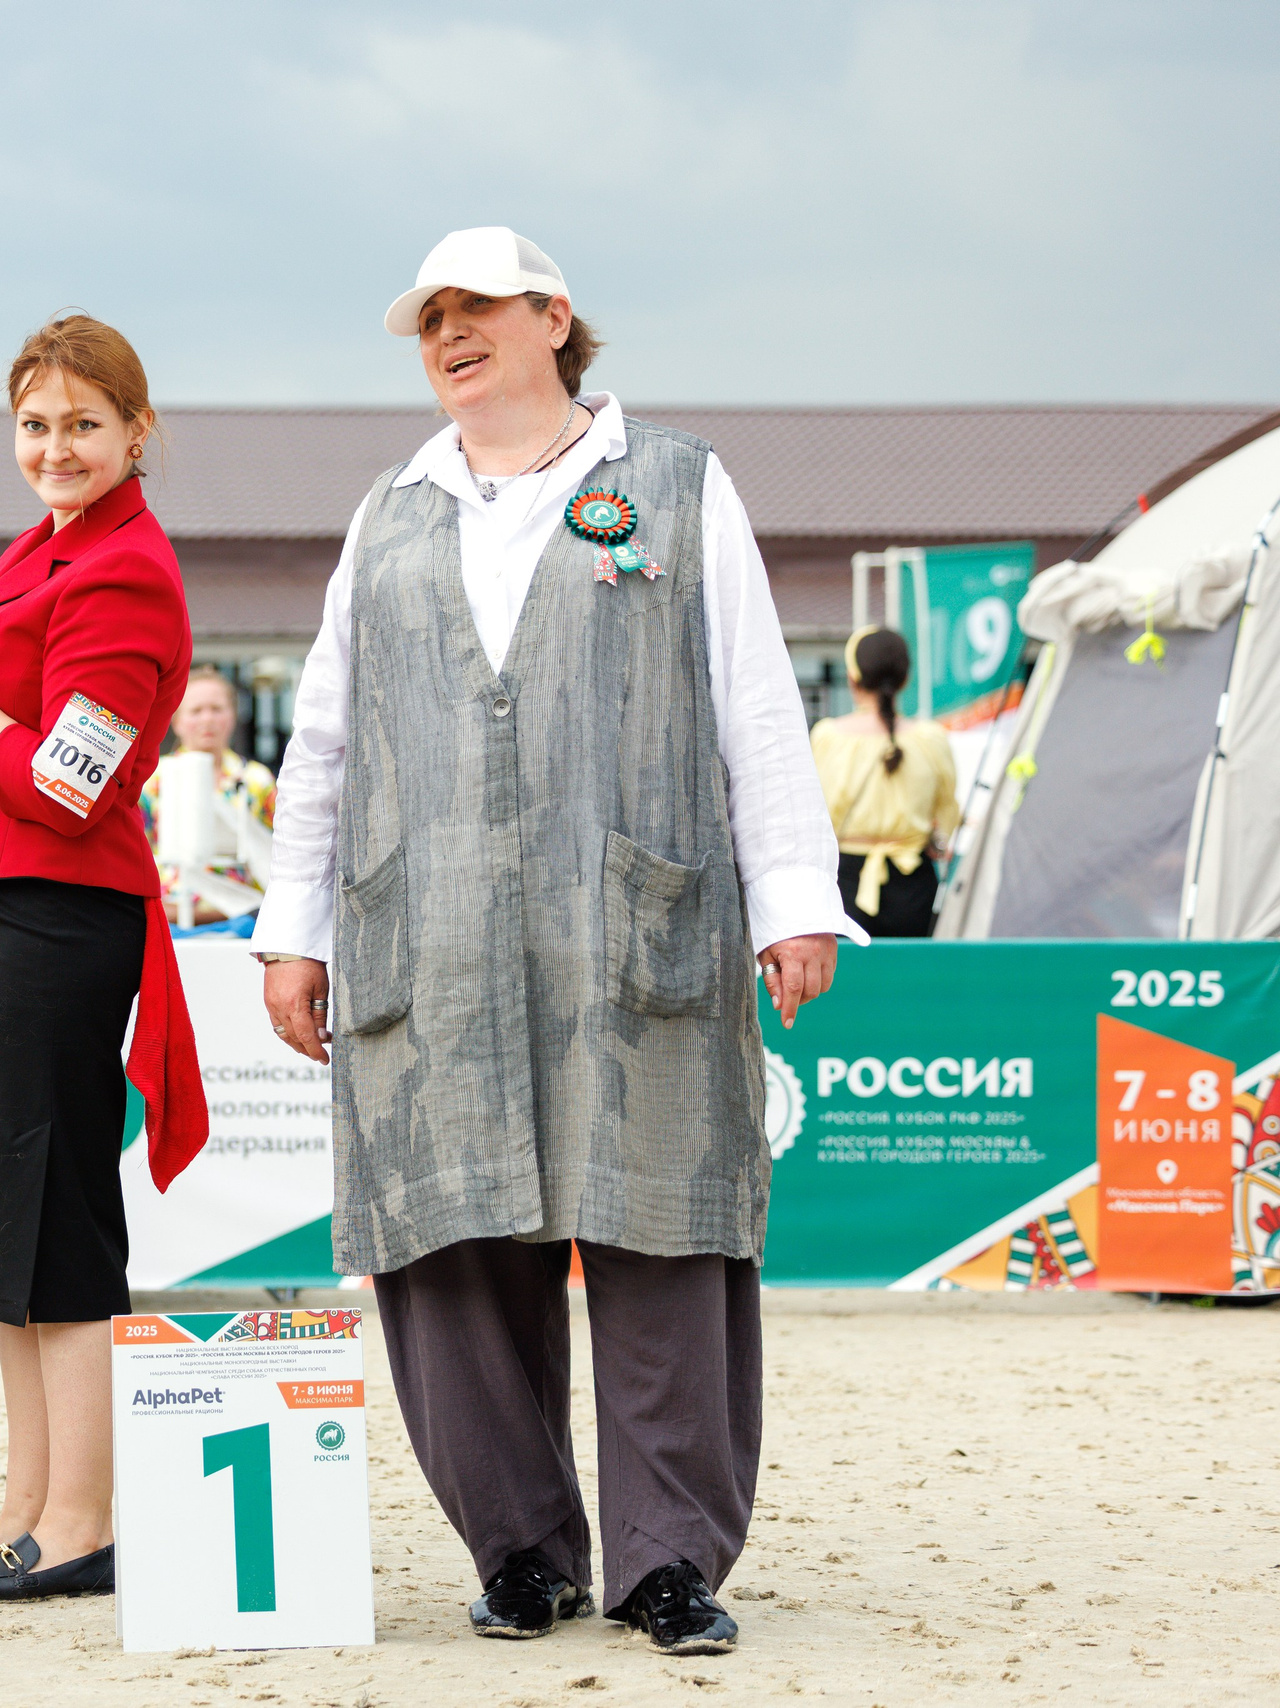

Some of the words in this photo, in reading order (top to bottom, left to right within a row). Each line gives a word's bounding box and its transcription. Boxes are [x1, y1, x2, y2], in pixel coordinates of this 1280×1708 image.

[966, 596, 1012, 682] 9
[89, 722, 116, 742] РОССИЯ
[49, 737, 106, 784] 1016
[55, 783, 89, 808] 8.06.2025
[1110, 969, 1225, 1008] 2025
[817, 1056, 1034, 1098] РОССИЯ
[1114, 1070, 1147, 1112] 7
[1186, 1070, 1221, 1112] 8
[895, 1110, 947, 1126] КУБОК
[1114, 1118, 1221, 1143] ИЮНЯ
[895, 1134, 947, 1149] КУБОК
[949, 1134, 1017, 1149] МОСКВЫ
[125, 1325, 158, 1337] 2025
[132, 1387, 223, 1409] AlphaPet
[291, 1386, 299, 1396] 7
[307, 1385, 315, 1395] 8
[316, 1384, 354, 1395] ИЮНЯ
[313, 1454, 350, 1462] РОССИЯ
[202, 1422, 277, 1613] 1
